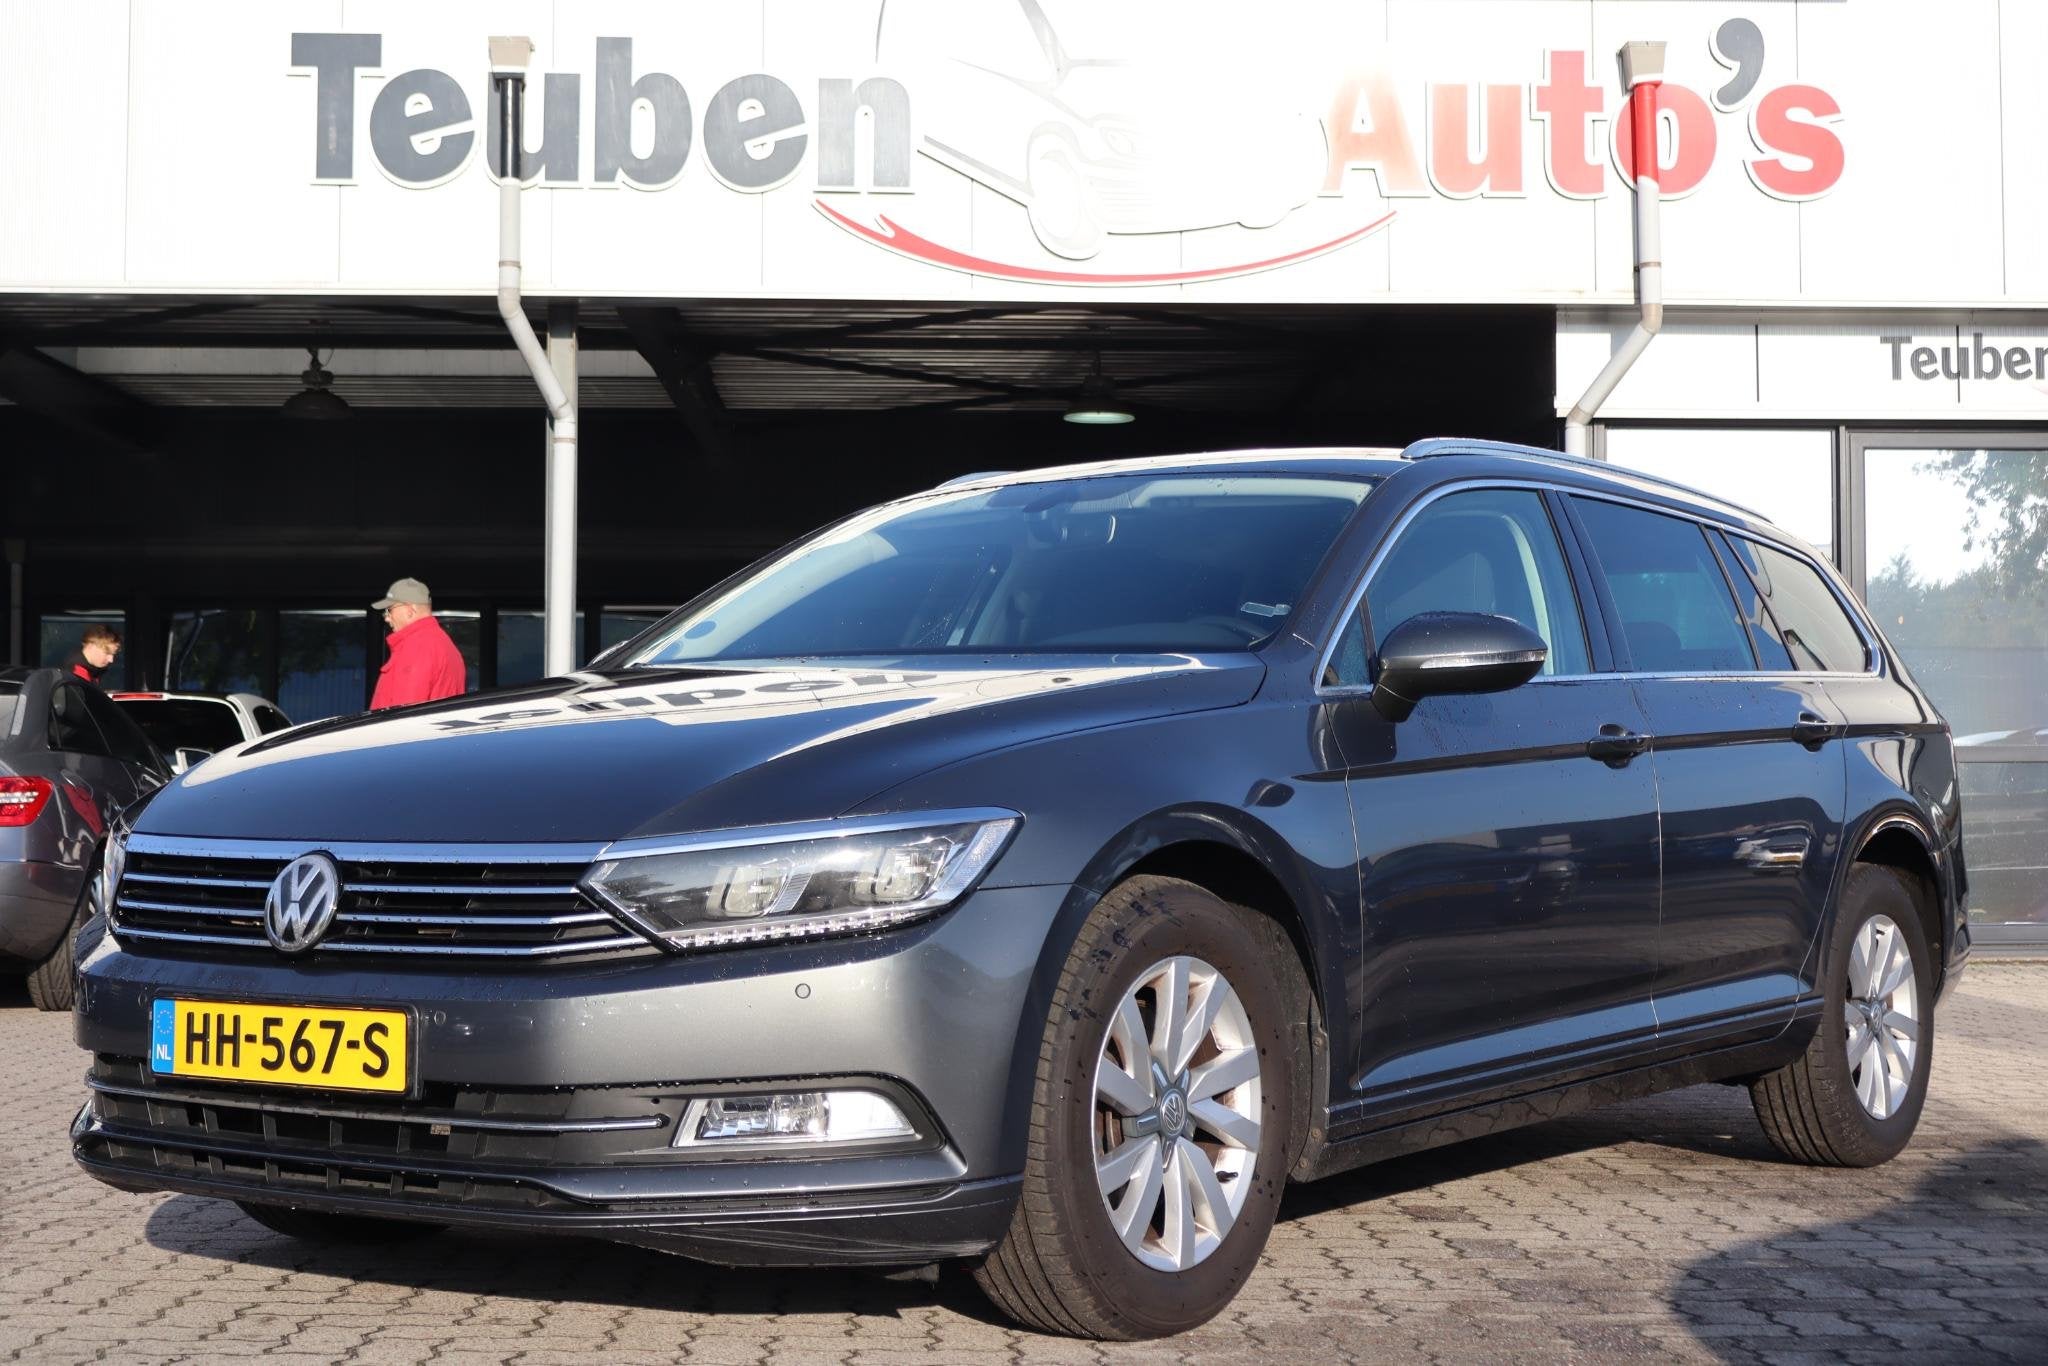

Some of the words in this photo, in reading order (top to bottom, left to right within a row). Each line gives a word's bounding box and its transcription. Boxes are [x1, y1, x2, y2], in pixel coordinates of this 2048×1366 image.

[290, 32, 912, 189] Teuben
[1320, 18, 1846, 195] Auto's
[156, 1043, 171, 1060] NL
[185, 1011, 389, 1078] HH-567-S
